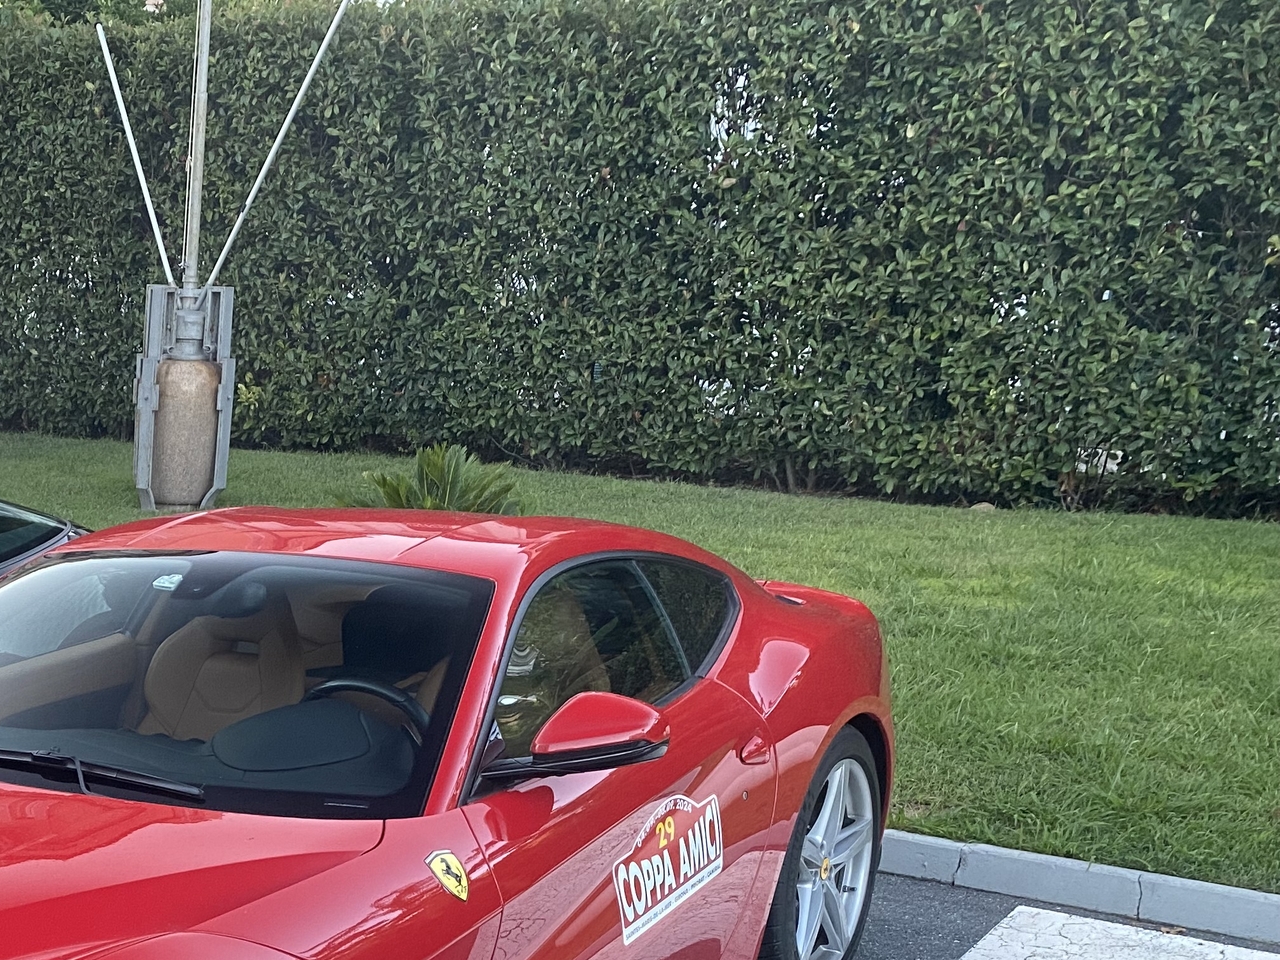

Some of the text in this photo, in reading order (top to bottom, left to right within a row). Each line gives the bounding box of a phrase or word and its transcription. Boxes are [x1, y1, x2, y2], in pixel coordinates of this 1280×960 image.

[676, 799, 692, 813] 2024
[655, 816, 675, 849] 29
[617, 849, 676, 922] COPPA
[678, 800, 720, 883] AMICI
